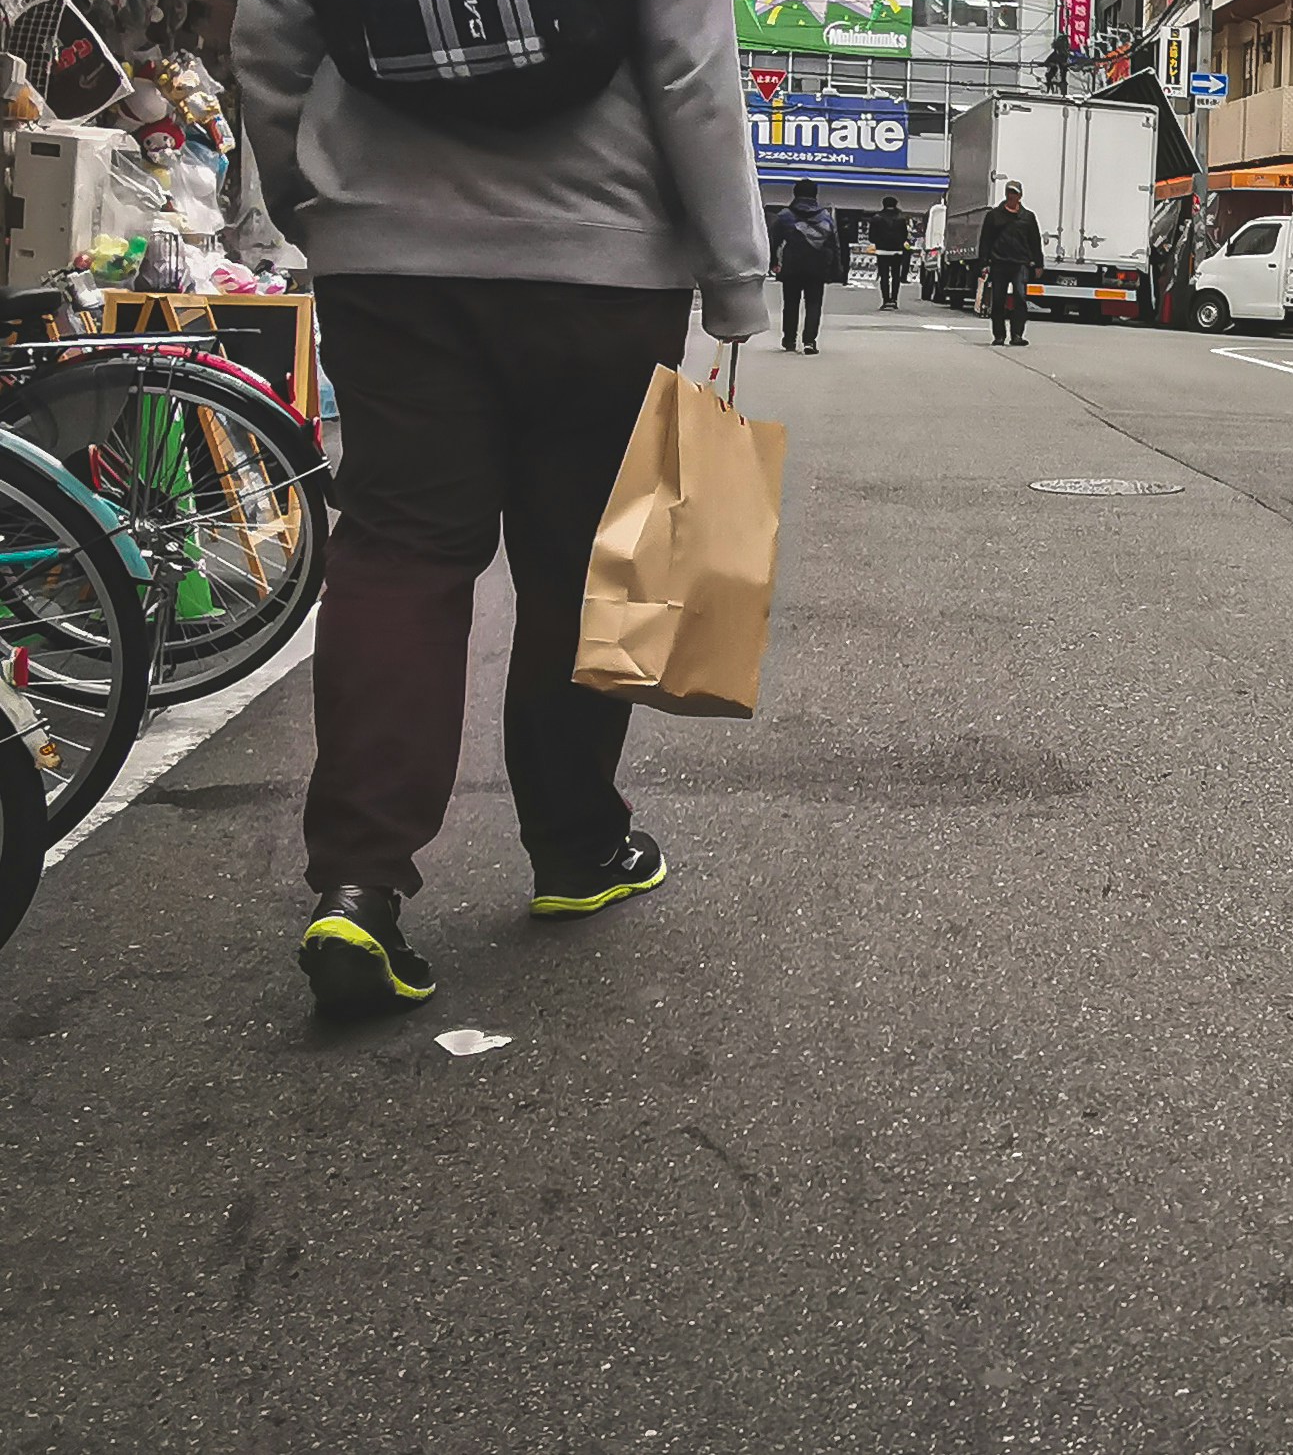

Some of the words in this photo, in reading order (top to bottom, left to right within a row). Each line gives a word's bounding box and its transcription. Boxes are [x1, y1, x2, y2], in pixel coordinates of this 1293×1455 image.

[756, 75, 779, 84] 止まれ
[748, 98, 905, 152] nimate
